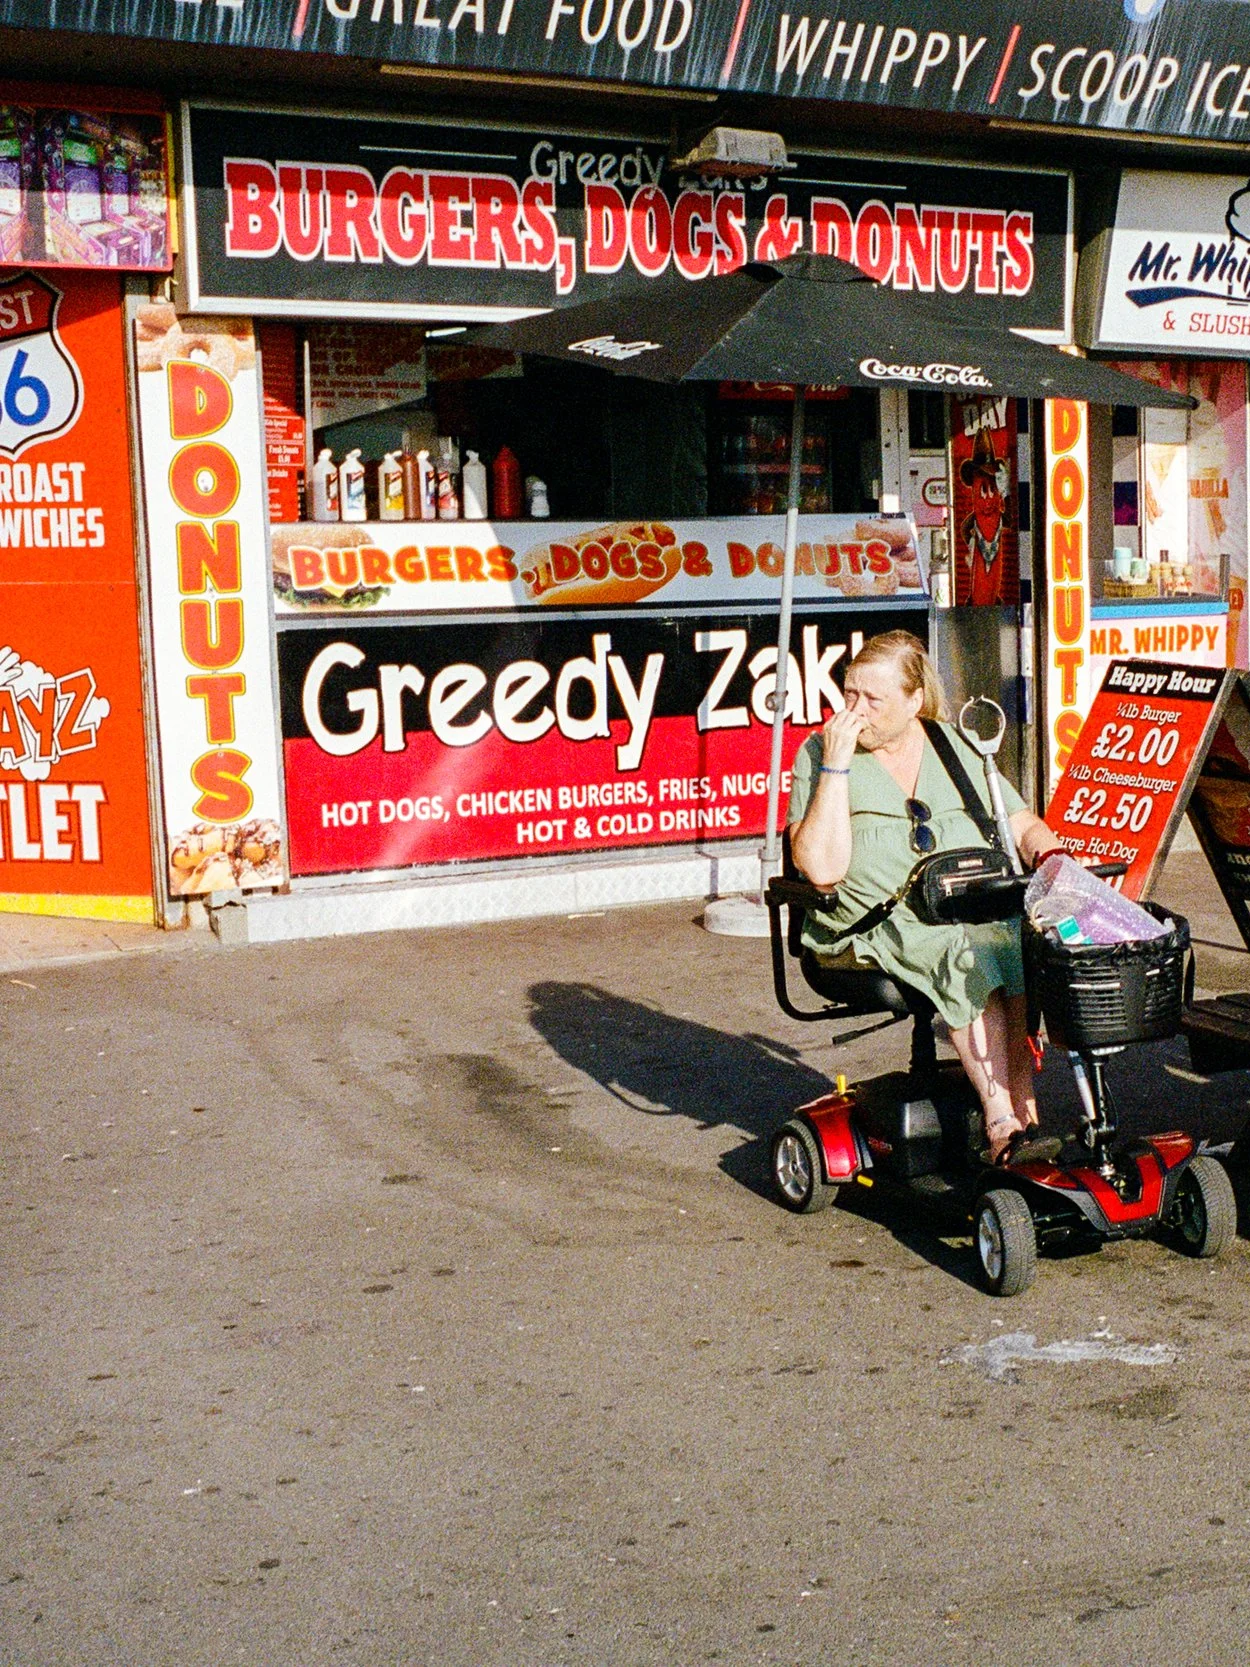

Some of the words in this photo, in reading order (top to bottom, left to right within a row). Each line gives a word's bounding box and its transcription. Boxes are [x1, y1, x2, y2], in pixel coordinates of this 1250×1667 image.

[544, 0, 694, 52] FOOD
[775, 11, 987, 92] WHIPPY
[1018, 43, 1179, 108] SCOOP
[529, 140, 665, 202] Greedy
[223, 157, 578, 295] BURGERS,
[585, 177, 747, 281] DOGS
[755, 193, 802, 262] &
[810, 197, 1035, 297] DONUTS
[1128, 240, 1182, 282] Mr.
[1162, 310, 1176, 331] &
[963, 396, 1009, 437] DAY
[549, 540, 666, 584] DOGS
[683, 542, 713, 576] &
[727, 539, 894, 578] DONUTS
[167, 359, 254, 824] DONUTS
[1050, 398, 1088, 773] DONUTS
[1090, 628, 1129, 656] MR.
[1134, 624, 1219, 654] WHIPPY
[302, 633, 665, 772] Greedy
[1108, 665, 1168, 695] Happy
[1167, 671, 1217, 693] Hour
[1139, 704, 1182, 725] Burger
[1090, 722, 1180, 767] £2.00
[321, 803, 373, 829] HOT
[379, 796, 451, 824] DOGS,
[456, 789, 556, 818] CHICKEN
[558, 781, 654, 810] BURGERS,
[660, 776, 718, 801] FRIES,
[1092, 767, 1176, 794] Cheeseburger
[0, 781, 107, 864] LET
[517, 821, 566, 845] HOT
[573, 817, 592, 838] &
[597, 811, 653, 837] COLD
[658, 805, 741, 832] DRINKS
[1063, 786, 1154, 833] £2.50
[1086, 833, 1109, 854] Hot
[1109, 837, 1139, 861] Dog
